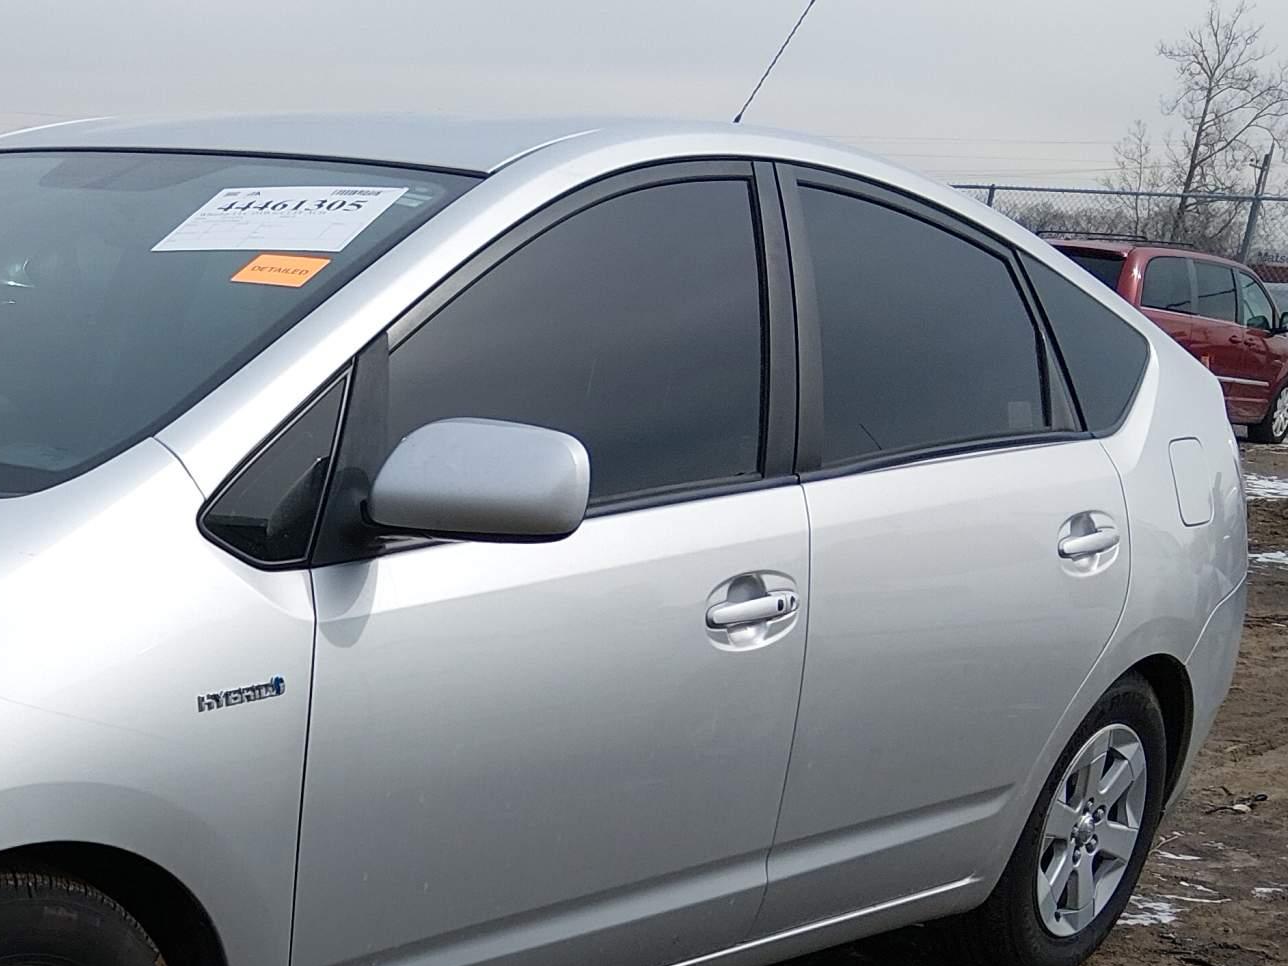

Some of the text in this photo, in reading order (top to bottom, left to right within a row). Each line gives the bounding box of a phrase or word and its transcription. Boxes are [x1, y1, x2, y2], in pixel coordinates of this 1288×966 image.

[217, 199, 368, 211] 44461305
[1257, 251, 1288, 263] Mats
[250, 264, 310, 276] DETAILED
[197, 678, 282, 713] HYBRID
